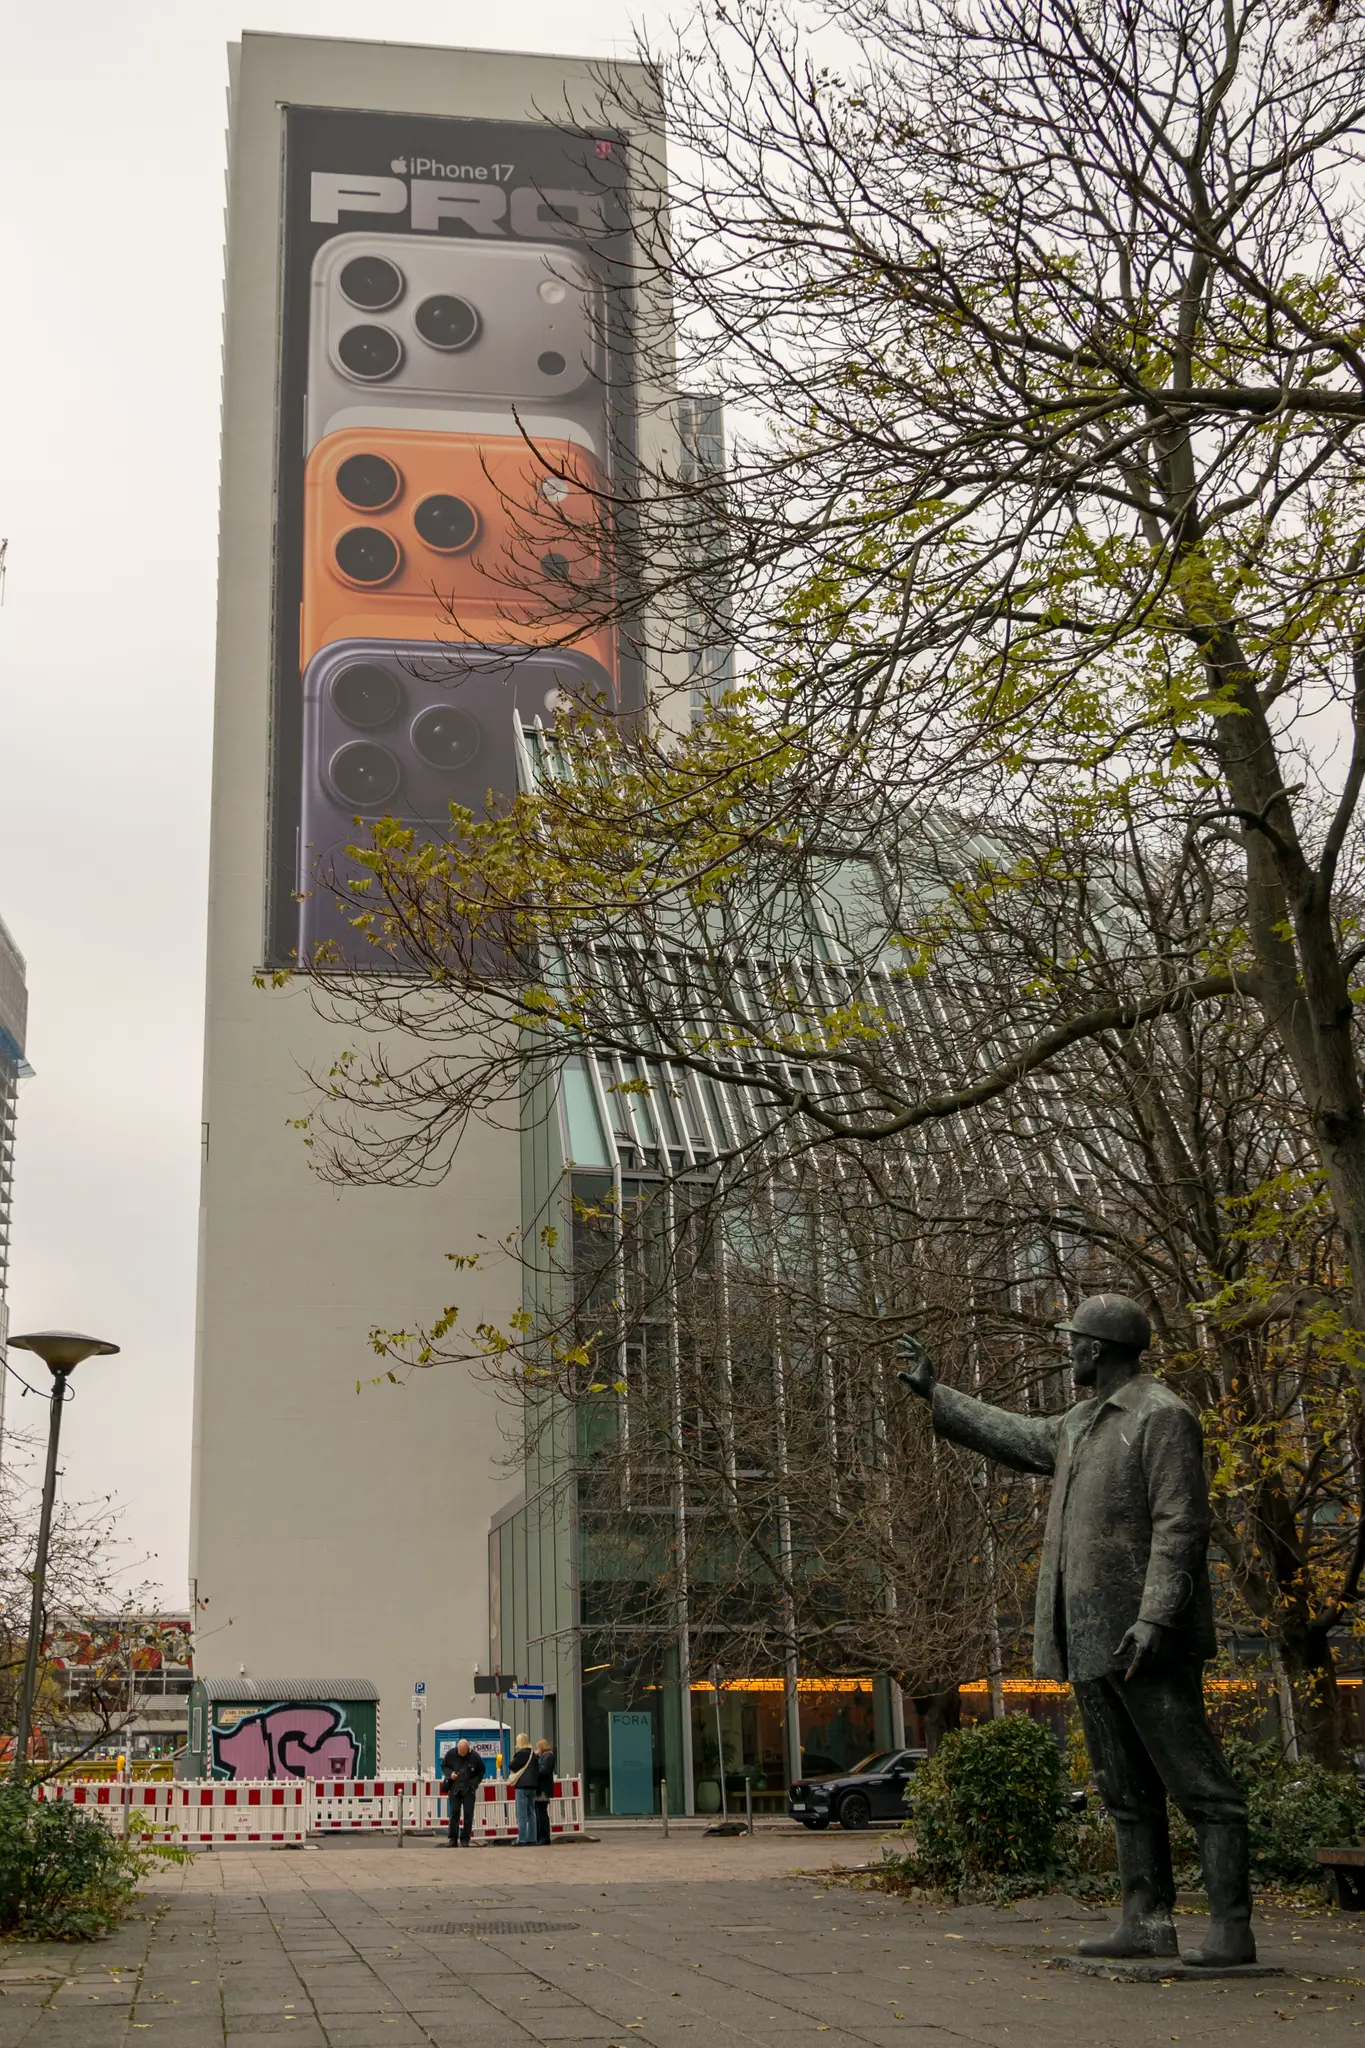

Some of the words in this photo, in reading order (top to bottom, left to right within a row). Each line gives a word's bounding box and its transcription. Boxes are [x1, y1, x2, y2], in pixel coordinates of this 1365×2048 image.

[410, 157, 488, 180] iPhone
[491, 163, 515, 182] 17
[310, 171, 606, 240] PRO
[613, 1715, 649, 1726] FORA
